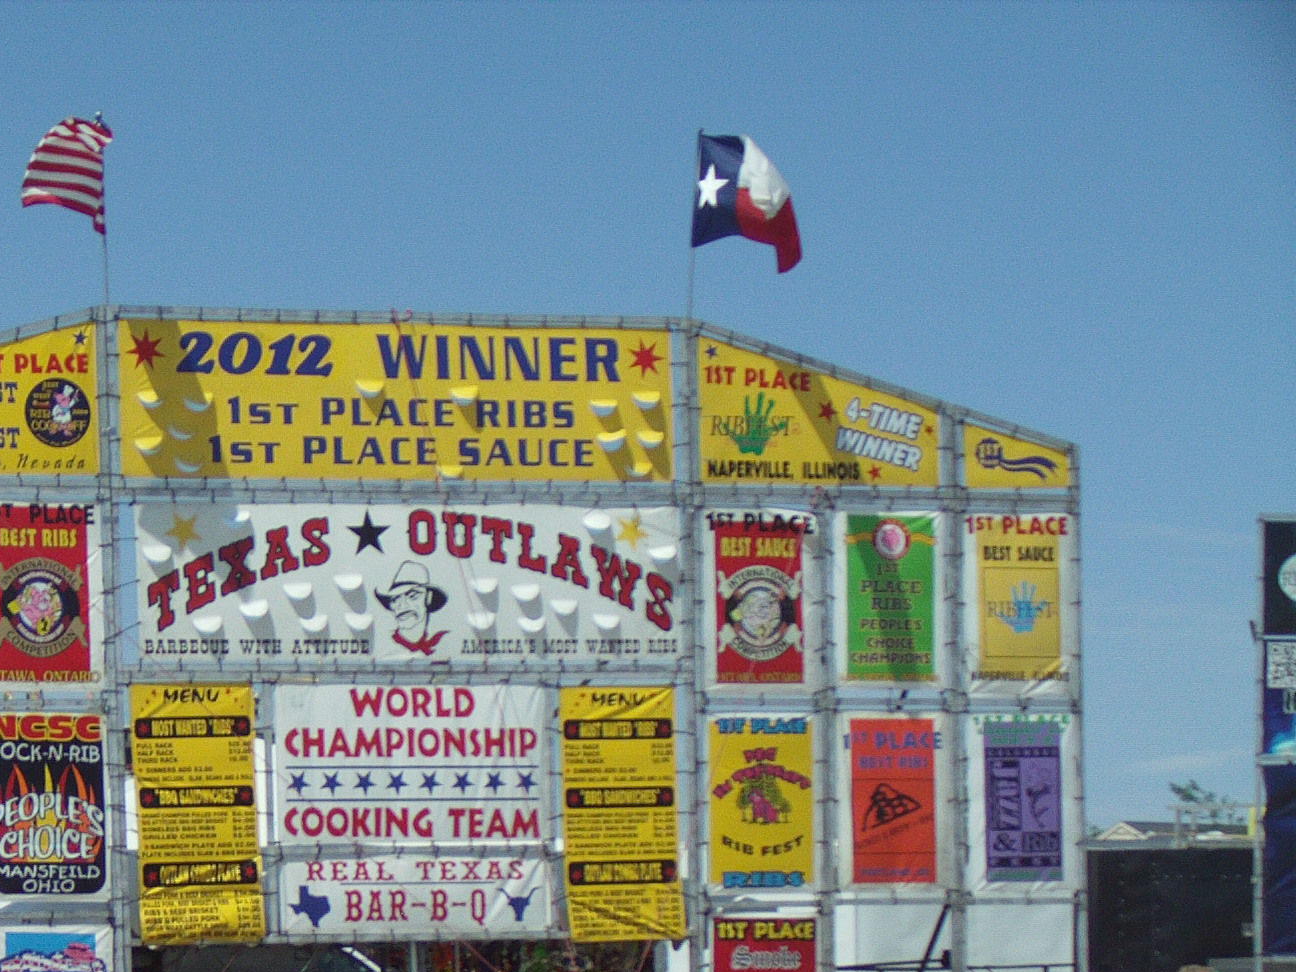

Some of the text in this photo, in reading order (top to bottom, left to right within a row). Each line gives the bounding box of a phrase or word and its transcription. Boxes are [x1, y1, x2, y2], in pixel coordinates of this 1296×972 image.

[14, 354, 89, 374] PLACE
[176, 332, 621, 382] 2012 WINNER
[705, 366, 811, 392] 1ST PLACE
[228, 396, 574, 429] 1ST PLACE RIBS
[845, 398, 923, 437] 4-TIME
[209, 436, 594, 468] 1ST PLACE SAUCE
[837, 426, 921, 471] WINNER
[17, 453, 86, 470] Nevada
[708, 460, 860, 480] NAPERVILLE, ILLINOIS
[29, 503, 95, 525] PLACE
[706, 512, 815, 534] 1ST PLACE
[965, 516, 1068, 535] 1ST PLACE
[0, 528, 77, 547] BEST RIBS
[721, 537, 797, 557] BEST SAUCE
[983, 546, 1054, 561] BEST SAUCE
[1, 559, 79, 587] INTERNATIONAL
[147, 509, 675, 632] TEXAS OUTLAWS
[861, 580, 922, 594] PLACE
[872, 598, 912, 610] RIBS
[7, 630, 77, 656] COMPETITION
[240, 639, 282, 654] WITH
[292, 639, 370, 654] ATTITUDE
[461, 639, 641, 654] AMERICA'S MOST WANTED
[164, 688, 220, 703] MENU
[349, 687, 475, 718] WORLD
[591, 692, 646, 706] MENU
[751, 718, 807, 734] PLACE
[284, 727, 537, 758] CHAMPIONSHIP
[874, 732, 943, 750] PLACE
[284, 807, 434, 838] COOKING
[449, 808, 541, 838] TEAM
[0, 824, 95, 860] CHOICE
[723, 834, 804, 856] RIB FEST
[306, 861, 524, 881] REAL TEXAS
[722, 870, 806, 889] RIBS
[22, 879, 75, 893] OHIO
[345, 888, 487, 926] BAR-B-Q
[717, 922, 814, 939] 1ST PLACE
